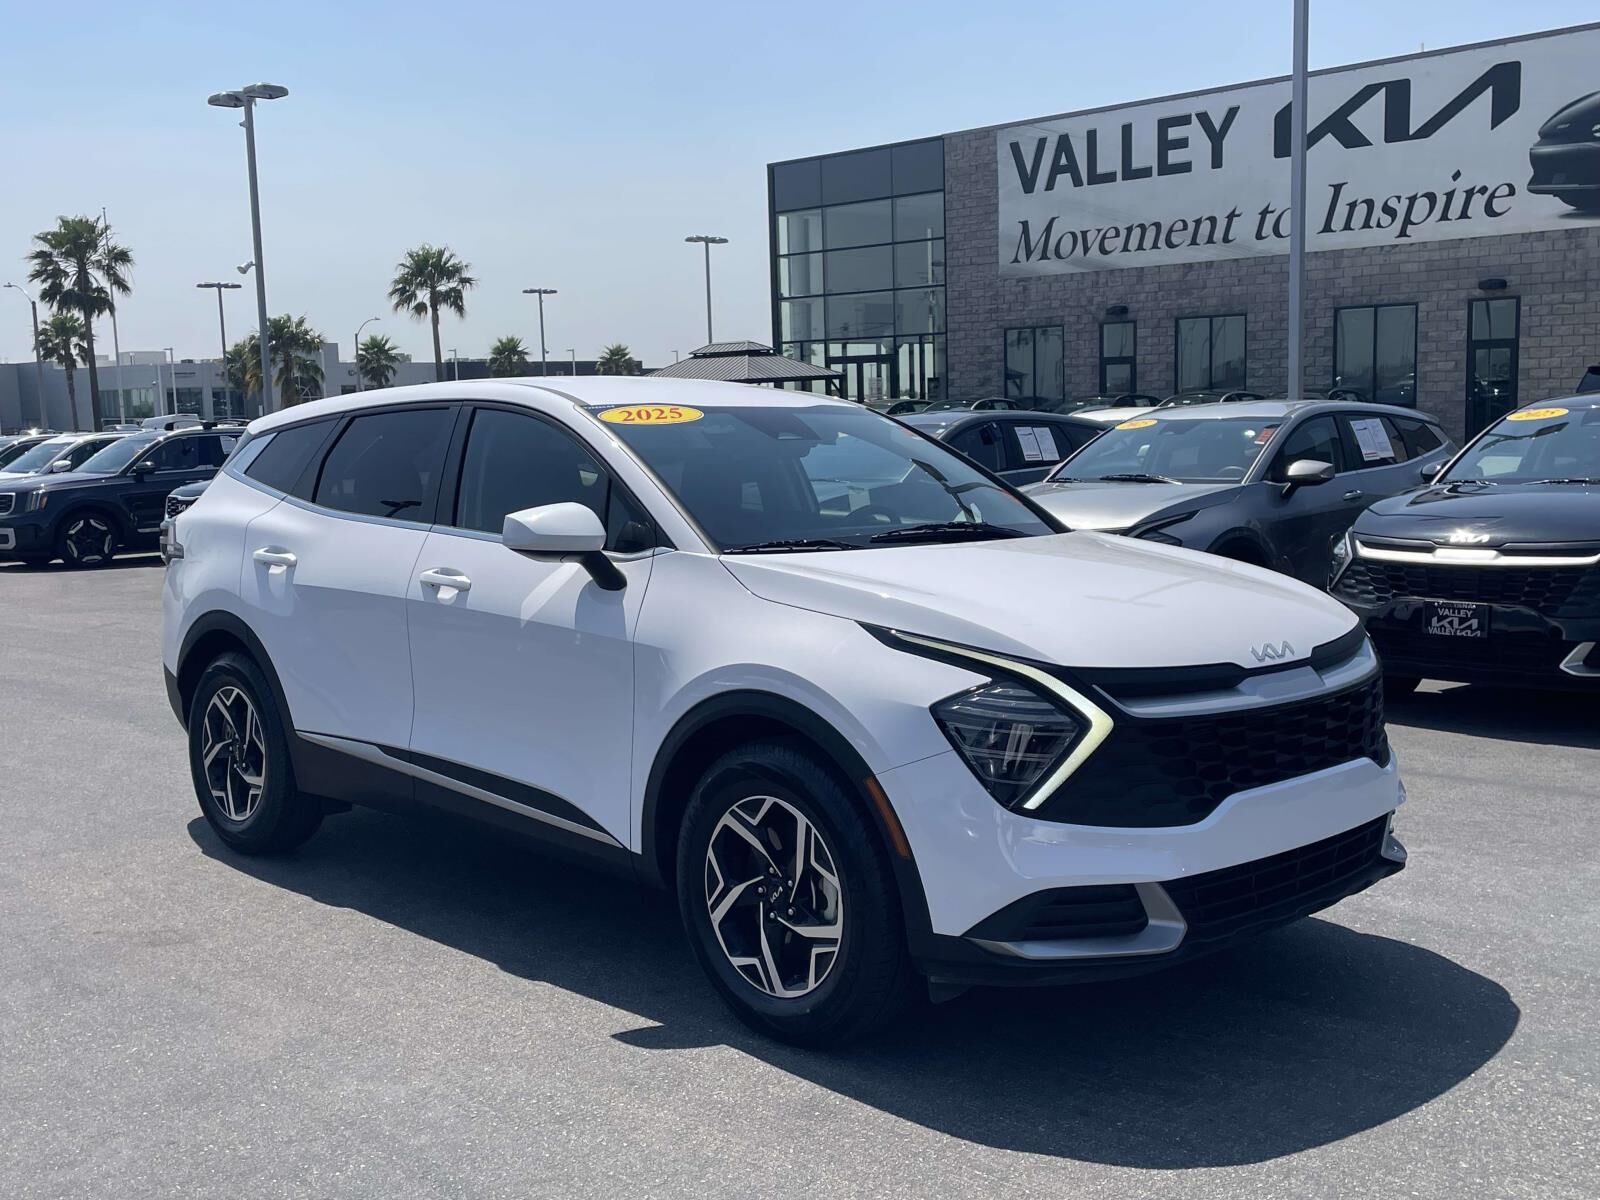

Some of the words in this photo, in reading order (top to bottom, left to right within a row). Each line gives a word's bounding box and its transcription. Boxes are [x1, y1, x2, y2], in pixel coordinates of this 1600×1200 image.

[1009, 105, 1241, 194] VALLEY
[1273, 61, 1522, 159] KIA
[1010, 206, 1243, 264] Movement
[1318, 169, 1516, 240] Inspire
[619, 407, 683, 422] 2025
[1437, 608, 1473, 618] VALLEY
[1428, 626, 1456, 636] VALLEY
[1431, 616, 1478, 631] KIA
[1250, 640, 1295, 662] KIA
